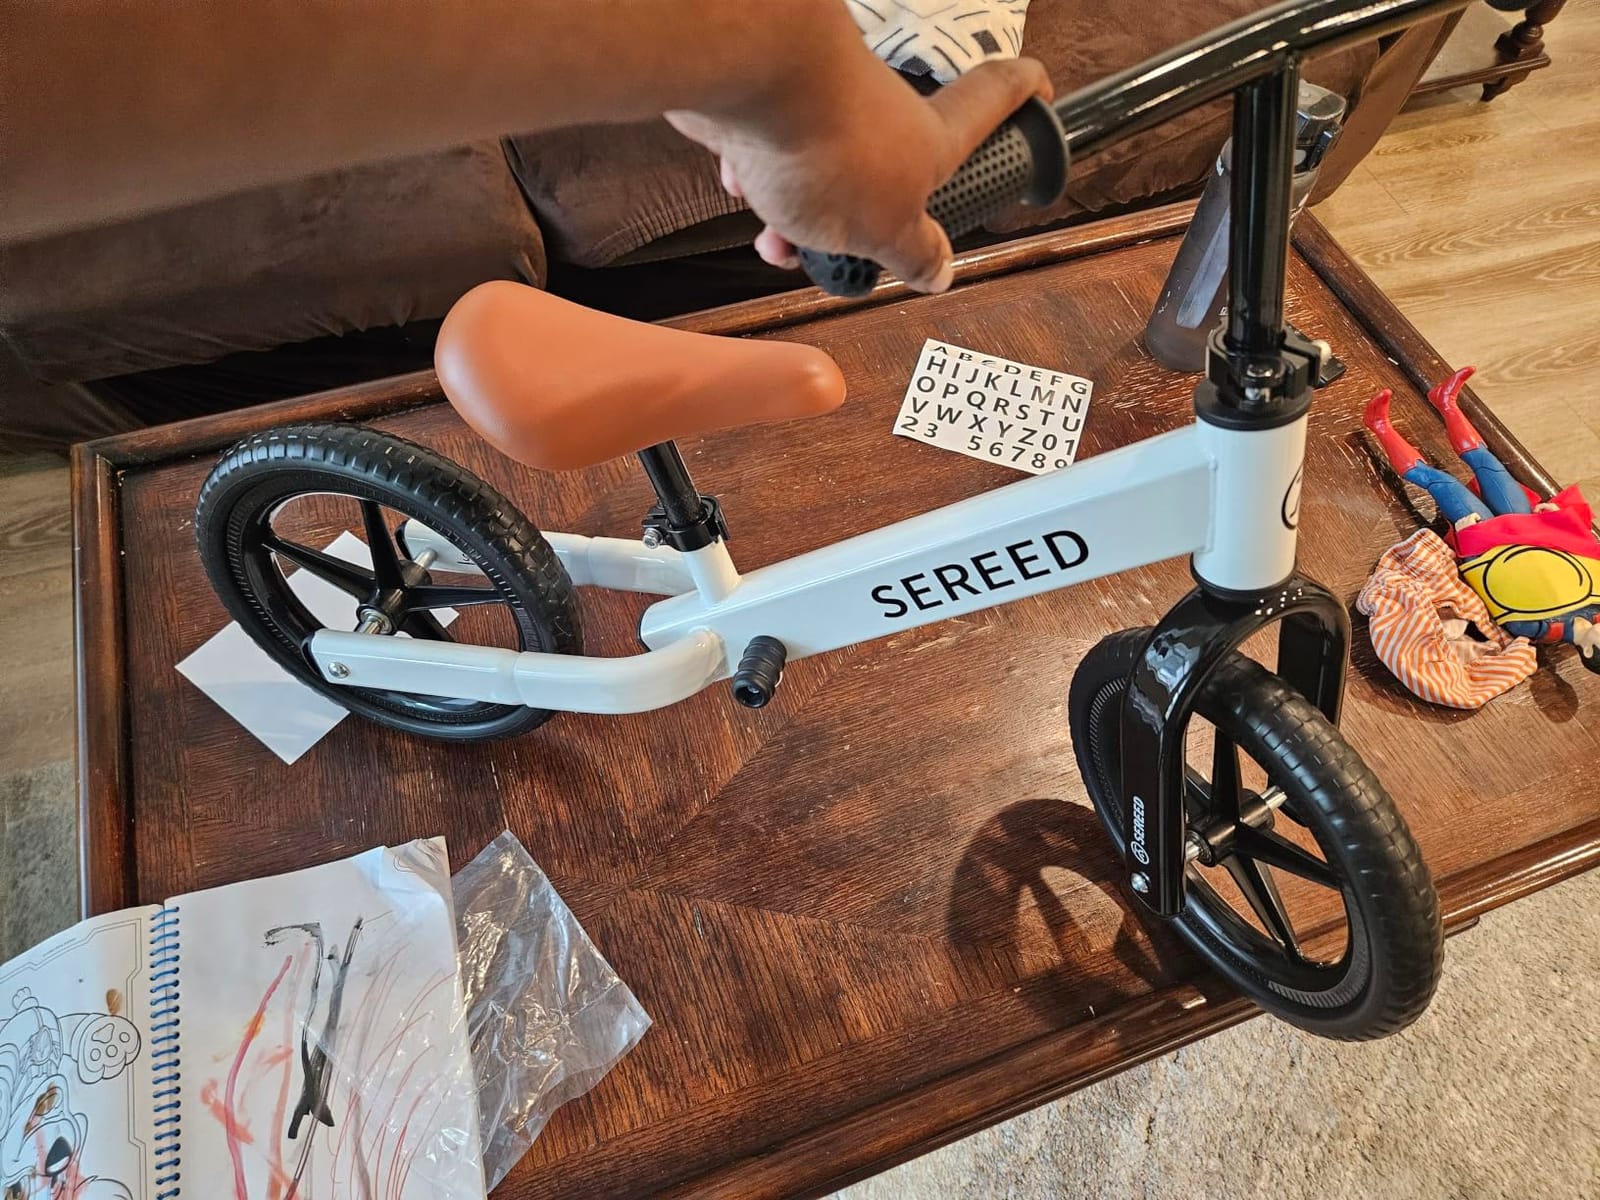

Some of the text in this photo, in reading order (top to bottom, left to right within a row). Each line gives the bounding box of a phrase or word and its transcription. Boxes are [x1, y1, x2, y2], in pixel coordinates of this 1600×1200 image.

[926, 355, 947, 375] H
[965, 368, 979, 384] J
[984, 372, 1002, 391] K
[1010, 379, 1022, 398] L
[1030, 385, 1056, 406] M
[1061, 394, 1082, 414] N
[958, 352, 973, 362] B
[1004, 364, 1021, 375] D
[1030, 370, 1043, 382] E
[1050, 375, 1063, 386] F
[1071, 381, 1087, 395] G
[911, 396, 929, 414] V
[937, 404, 962, 425] W
[967, 413, 988, 433] X
[998, 420, 1014, 438] Y
[1018, 427, 1038, 447] Z
[1064, 439, 1075, 456] 1
[942, 382, 959, 399] P
[966, 390, 986, 411] Q
[993, 397, 1010, 416] R
[1015, 404, 1031, 421] S
[1039, 409, 1055, 426] T
[1062, 415, 1081, 432] U
[900, 415, 919, 433] 2
[923, 422, 939, 439] 3
[967, 435, 983, 451] 5
[989, 441, 1003, 458] 6
[1011, 446, 1026, 463] 7
[1031, 452, 1047, 469] 8
[871, 530, 1089, 618] SEREED
[1133, 796, 1145, 846] SEREED
